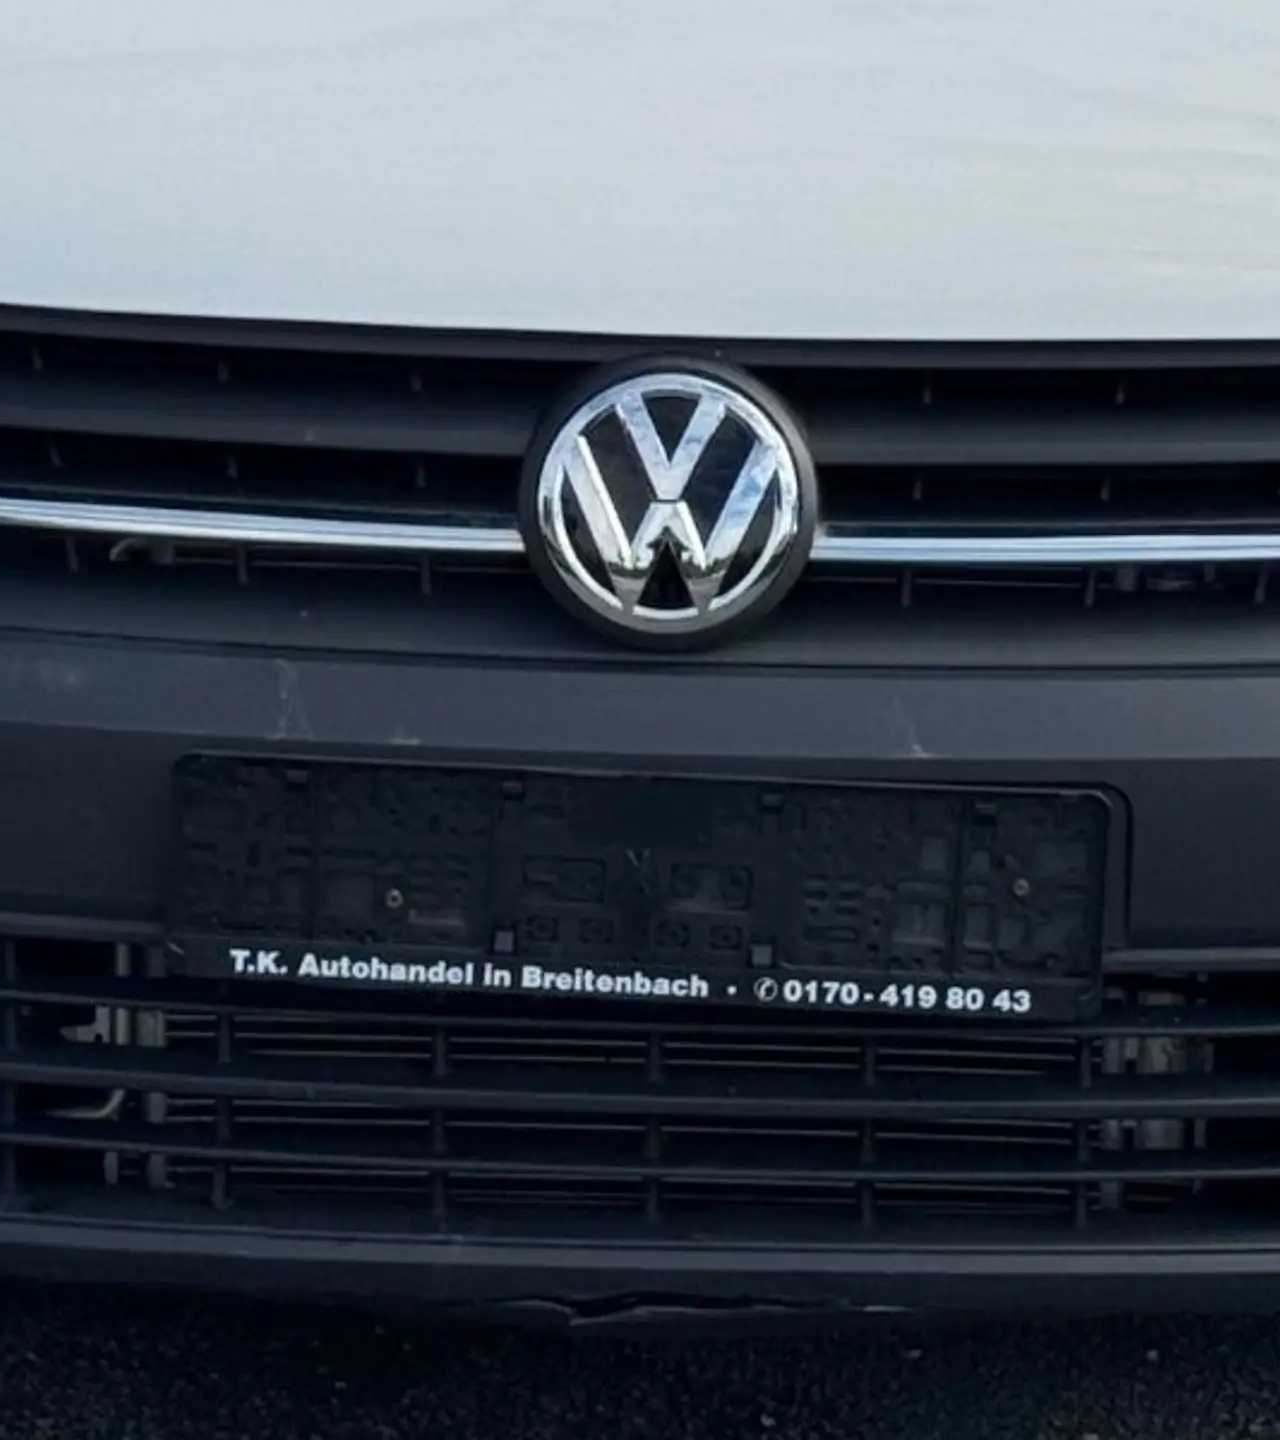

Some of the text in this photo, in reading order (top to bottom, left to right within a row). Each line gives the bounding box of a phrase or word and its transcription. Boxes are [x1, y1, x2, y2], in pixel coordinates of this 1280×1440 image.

[229, 948, 289, 975] T.K.
[297, 952, 475, 986] Autohandel
[482, 962, 512, 988] in
[521, 965, 710, 998] Breitenbach
[945, 986, 985, 1012] 80
[992, 989, 1032, 1013] 43
